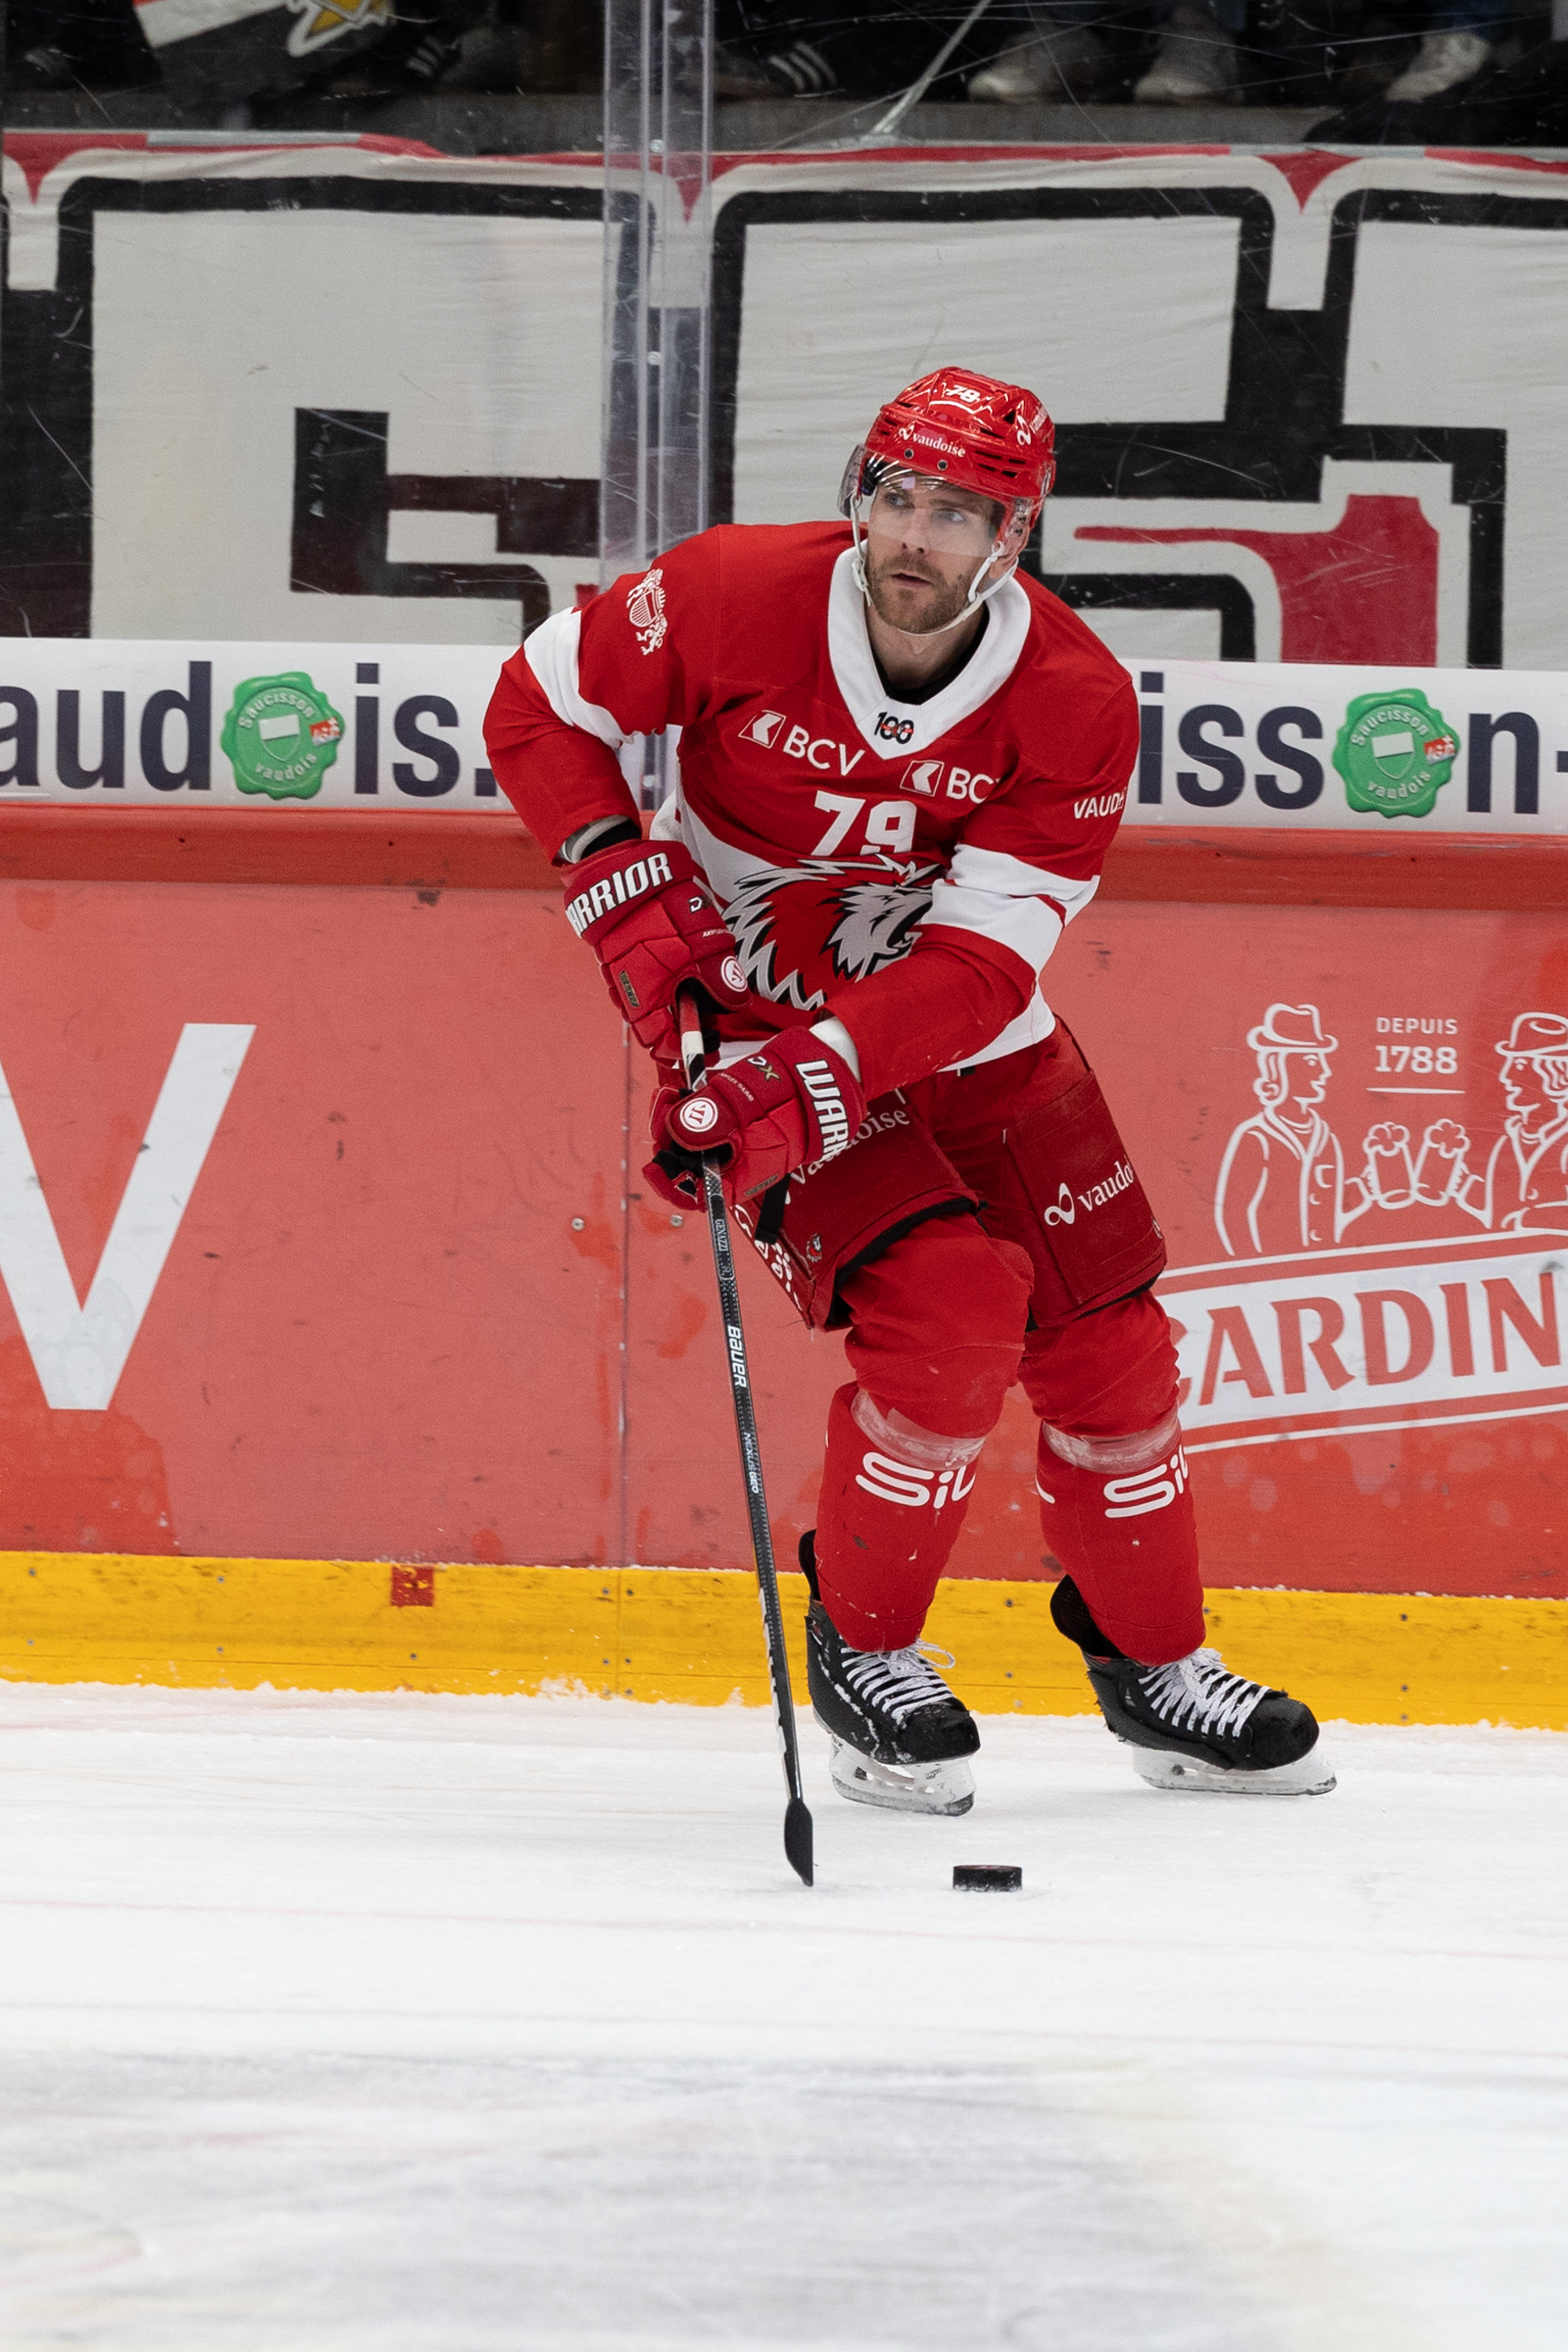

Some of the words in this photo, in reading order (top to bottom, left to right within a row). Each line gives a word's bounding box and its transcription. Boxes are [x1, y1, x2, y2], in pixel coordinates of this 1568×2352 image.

[912, 431, 967, 458] vaudoise
[255, 753, 317, 782] vaudois
[782, 724, 866, 777] BCV
[946, 767, 1001, 804] BC
[1367, 771, 1431, 800] vaudois
[811, 789, 917, 857] 79
[1376, 1017, 1458, 1036] DEPUIS
[1375, 1045, 1458, 1074] 1788
[791, 1109, 910, 1185] vaoise
[1077, 1154, 1135, 1212] vaudo
[0, 1022, 257, 1411] V
